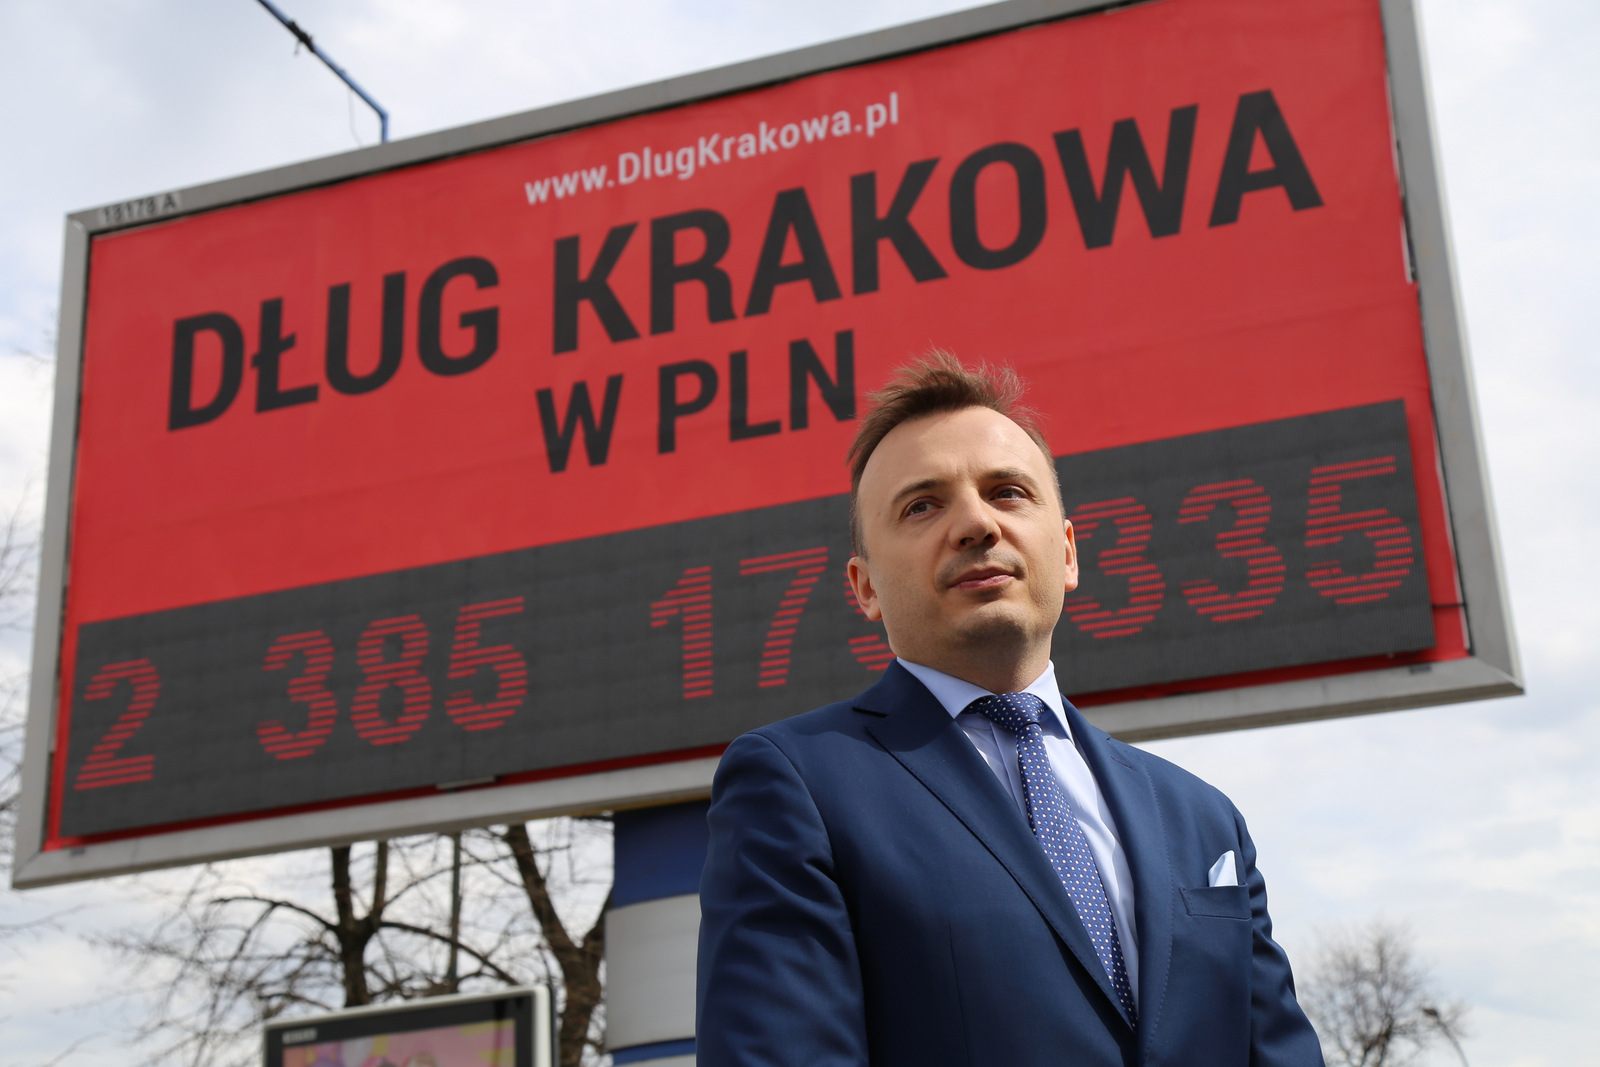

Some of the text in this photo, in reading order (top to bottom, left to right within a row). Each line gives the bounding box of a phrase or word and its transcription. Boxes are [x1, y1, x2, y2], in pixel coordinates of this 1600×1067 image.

[167, 88, 1324, 432] DŁUG KRAKOWA
[525, 91, 899, 204] www.DlugKrakowa.pl
[535, 330, 856, 474] W PLN
[74, 657, 161, 791] 2
[256, 596, 528, 760] 385
[1064, 455, 1414, 640] 335
